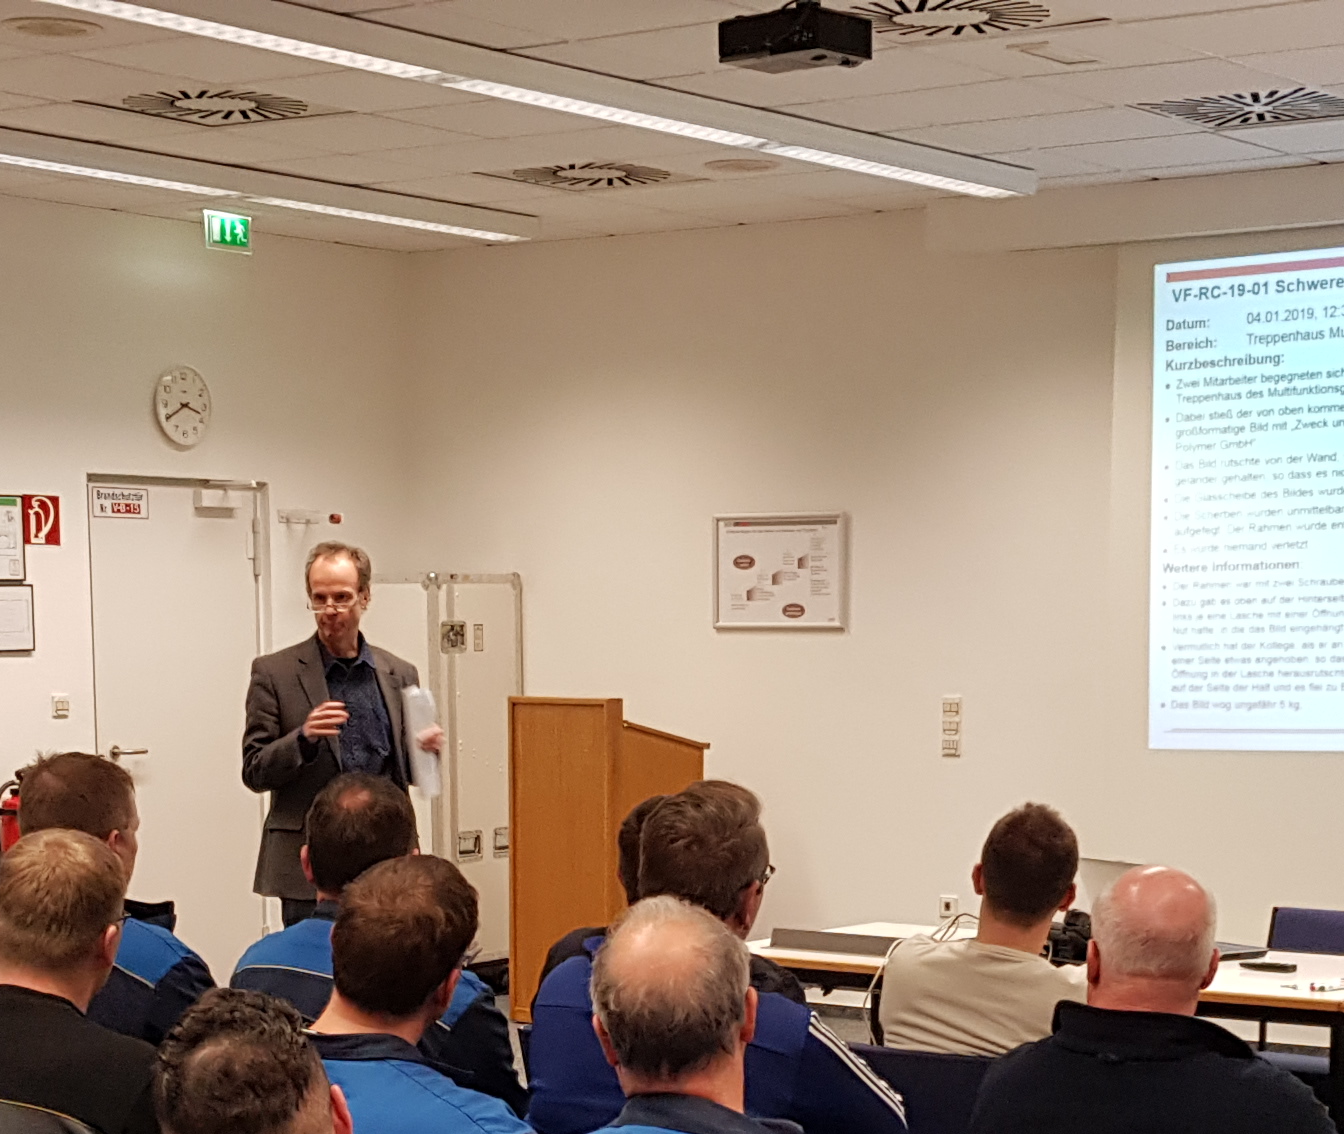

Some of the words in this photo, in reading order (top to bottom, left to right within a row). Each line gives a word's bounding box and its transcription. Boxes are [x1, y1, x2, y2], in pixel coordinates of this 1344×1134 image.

[1171, 281, 1268, 302] VF-RC-19-01
[1165, 316, 1210, 331] Datum:
[1165, 336, 1217, 351] Bereich:
[1245, 327, 1325, 347] Treppenhaus
[1165, 351, 1284, 373] Kurzbeschreibung:
[1175, 377, 1200, 389] Zwei
[1203, 374, 1257, 387] Mitarbeiter
[1260, 370, 1323, 385] begegneten
[1176, 389, 1242, 404] Treppenhaus
[1245, 389, 1264, 399] des
[1236, 408, 1253, 418] der
[1256, 408, 1275, 417] von
[1277, 405, 1304, 415] oben
[1249, 421, 1268, 432] Bild
[1271, 421, 1287, 430] mit
